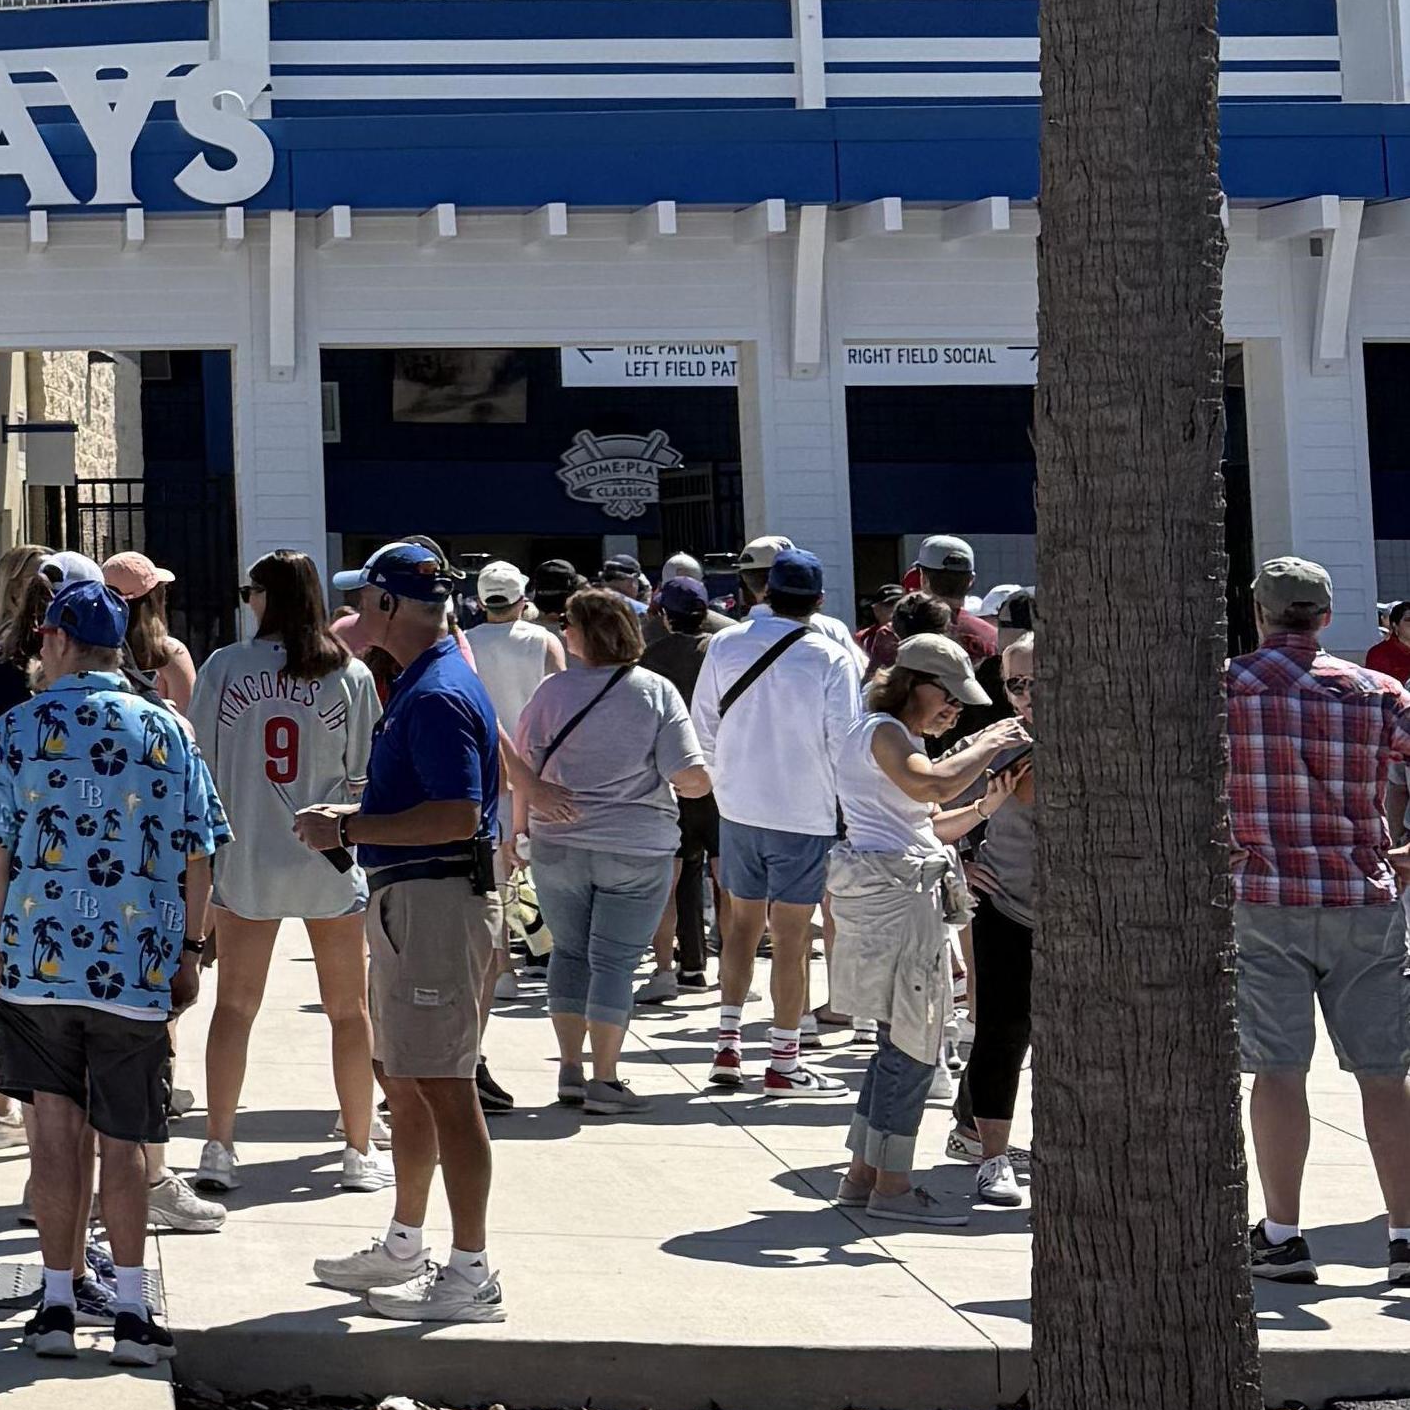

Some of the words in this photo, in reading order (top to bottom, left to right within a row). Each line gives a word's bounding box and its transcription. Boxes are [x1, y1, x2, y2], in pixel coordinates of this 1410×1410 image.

[848, 348, 891, 364] RIGHT
[898, 348, 938, 364] FIELD
[943, 347, 997, 364] SOCIAL
[625, 361, 659, 377] LEFT
[665, 361, 706, 377] FIELD
[711, 360, 738, 376] PAT
[596, 487, 652, 497] CLASSICS
[264, 715, 300, 784] 9
[74, 777, 103, 808] TB
[70, 888, 101, 920] TB
